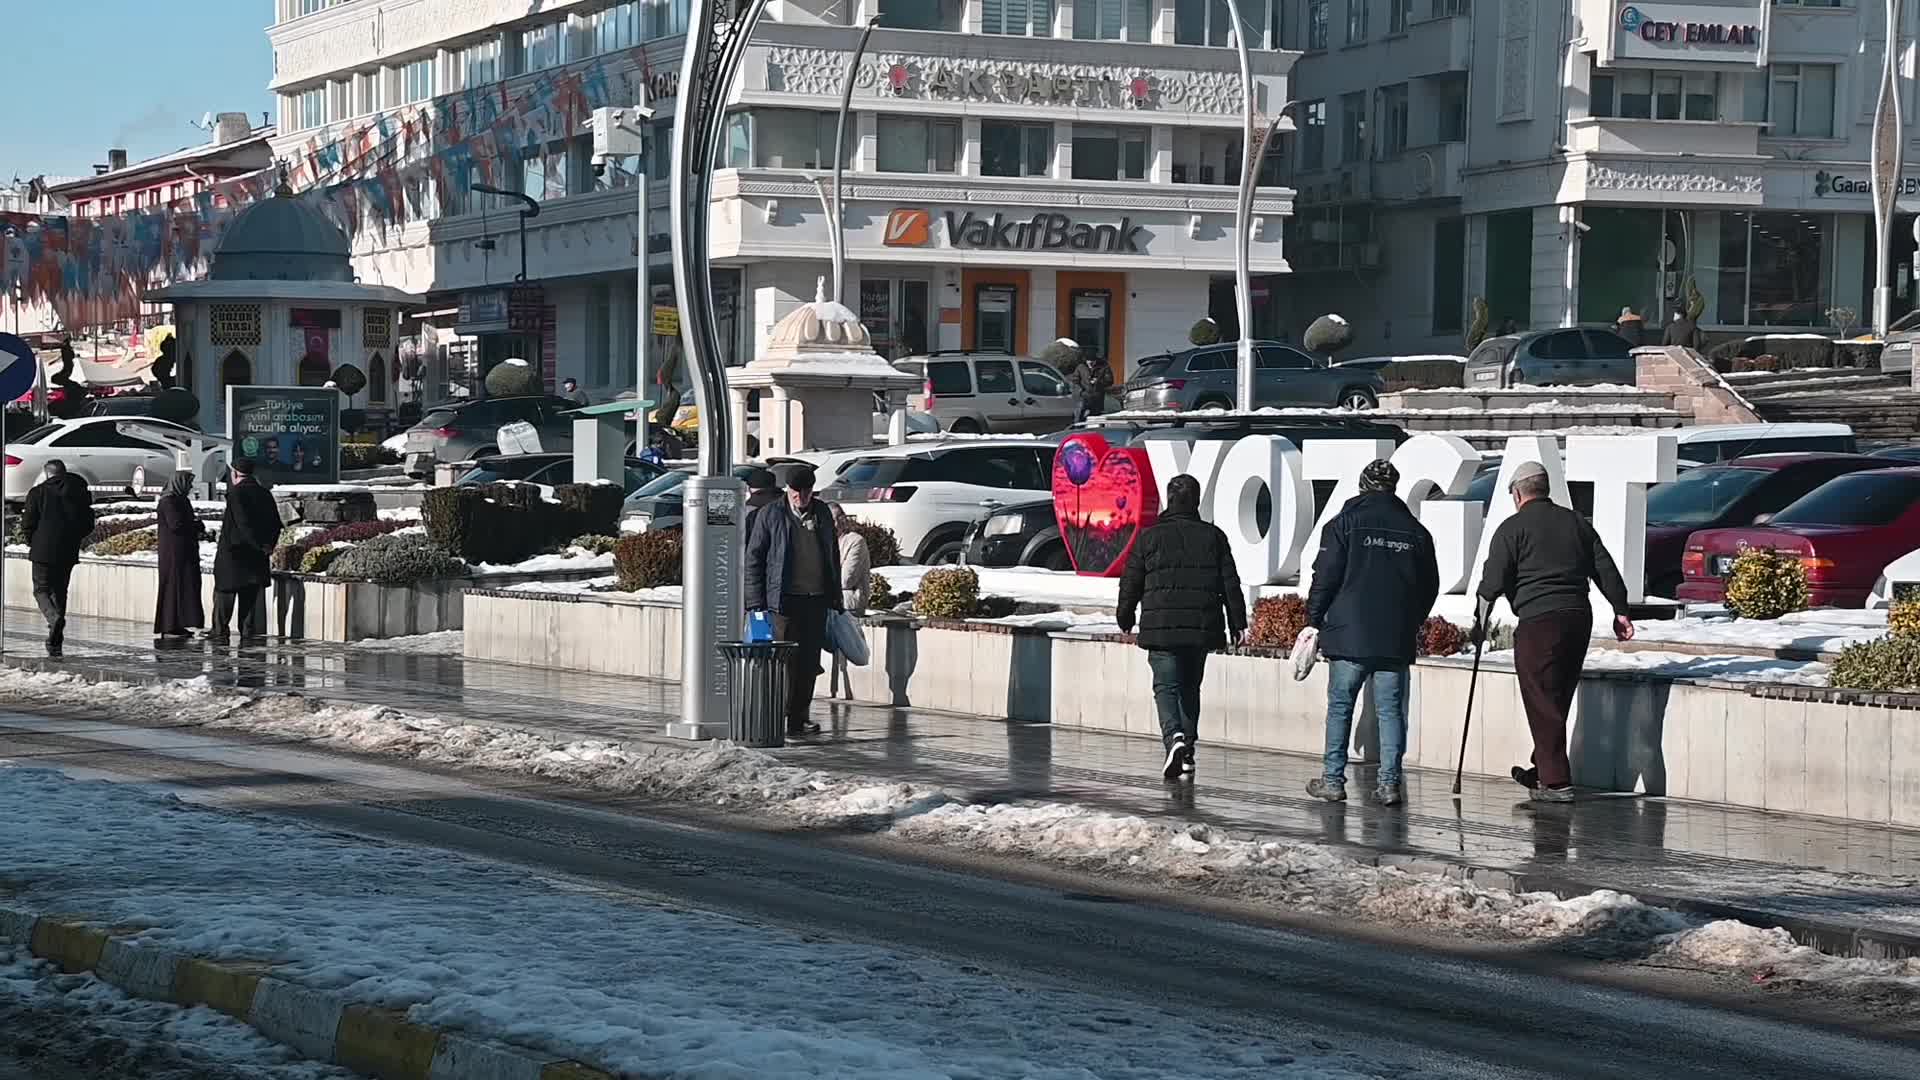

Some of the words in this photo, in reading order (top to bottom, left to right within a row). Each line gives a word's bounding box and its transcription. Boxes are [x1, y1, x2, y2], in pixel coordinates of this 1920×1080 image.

[1640, 20, 1679, 41] CEY
[1683, 23, 1760, 45] EMLAK
[930, 67, 985, 97] AK
[944, 209, 1146, 253] VakıfBank
[265, 399, 304, 412] Türkiye
